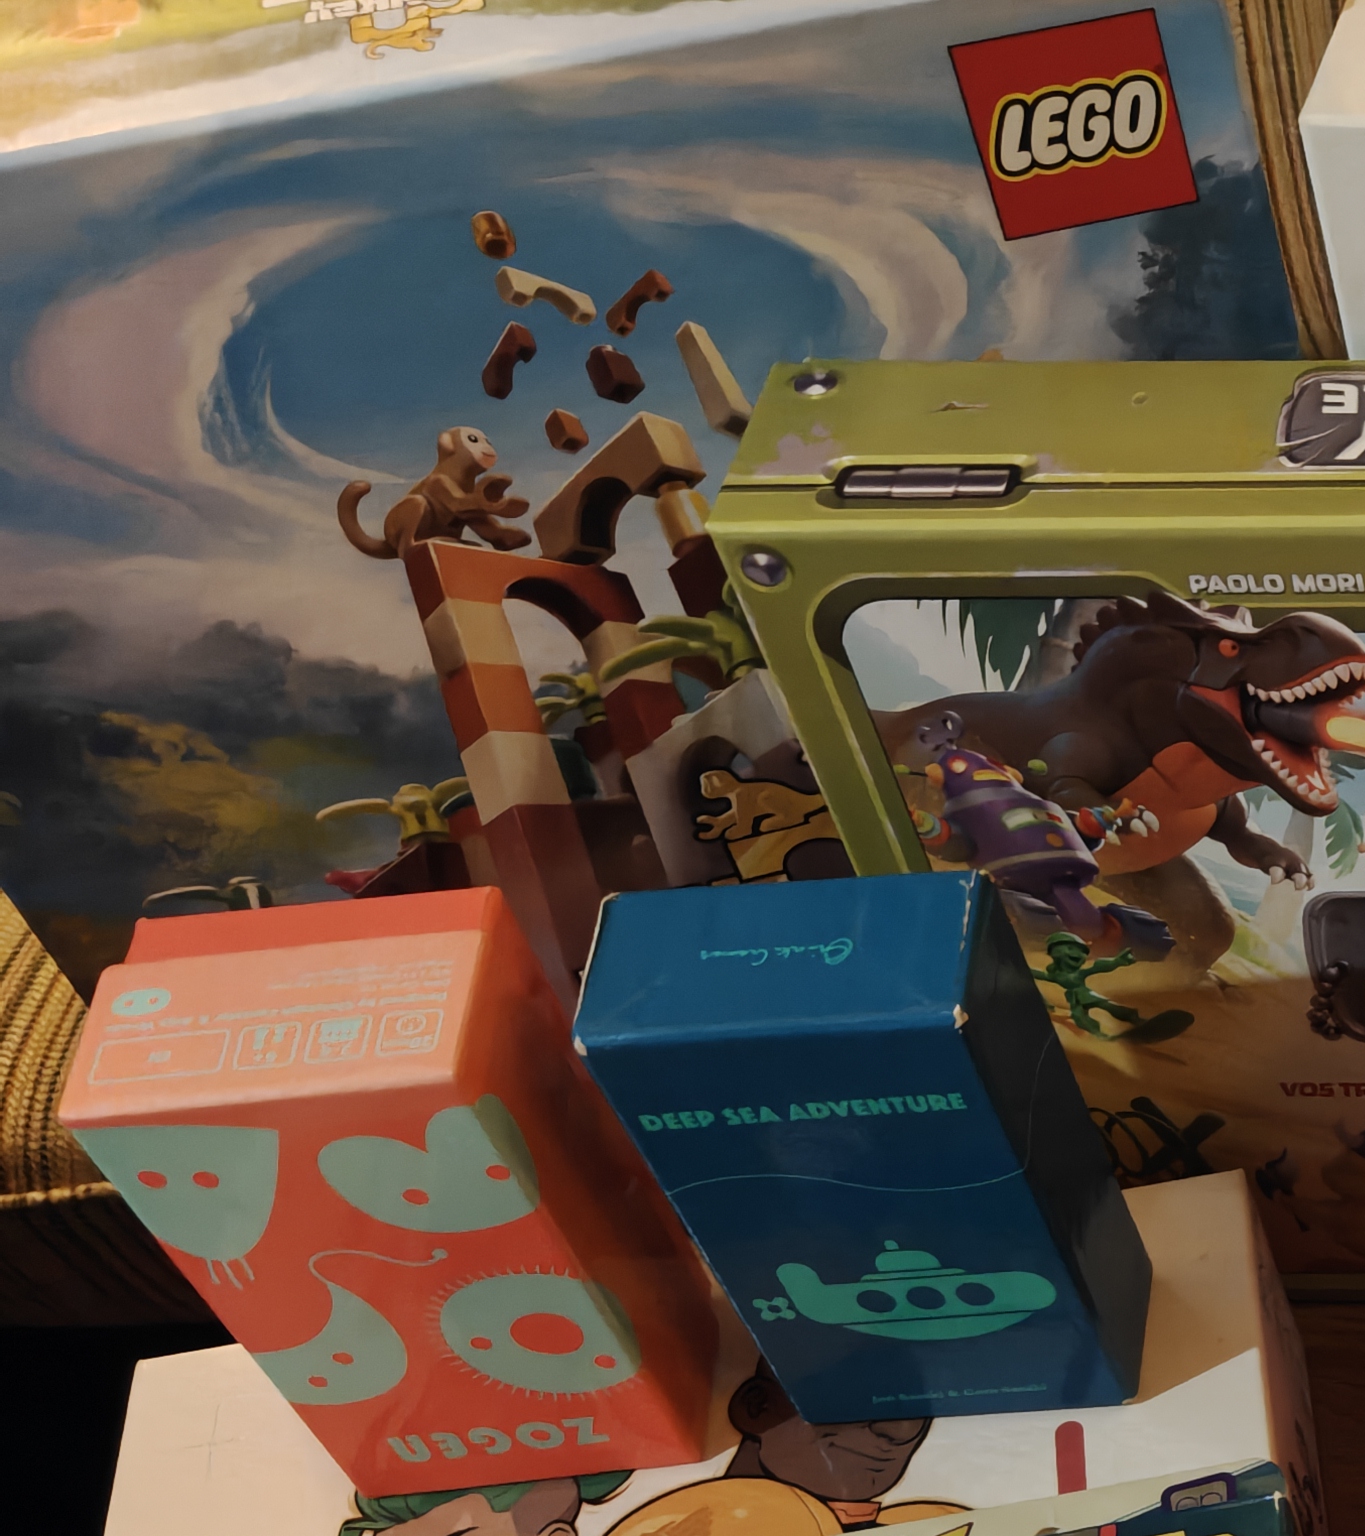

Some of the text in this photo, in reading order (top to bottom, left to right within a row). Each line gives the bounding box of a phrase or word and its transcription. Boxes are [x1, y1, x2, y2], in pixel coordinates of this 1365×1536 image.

[998, 76, 1160, 174] LEGO
[1189, 573, 1286, 594] PAOLO
[1293, 573, 1365, 594] MORI
[639, 1093, 967, 1132] DEEP SEA ADVENTURE
